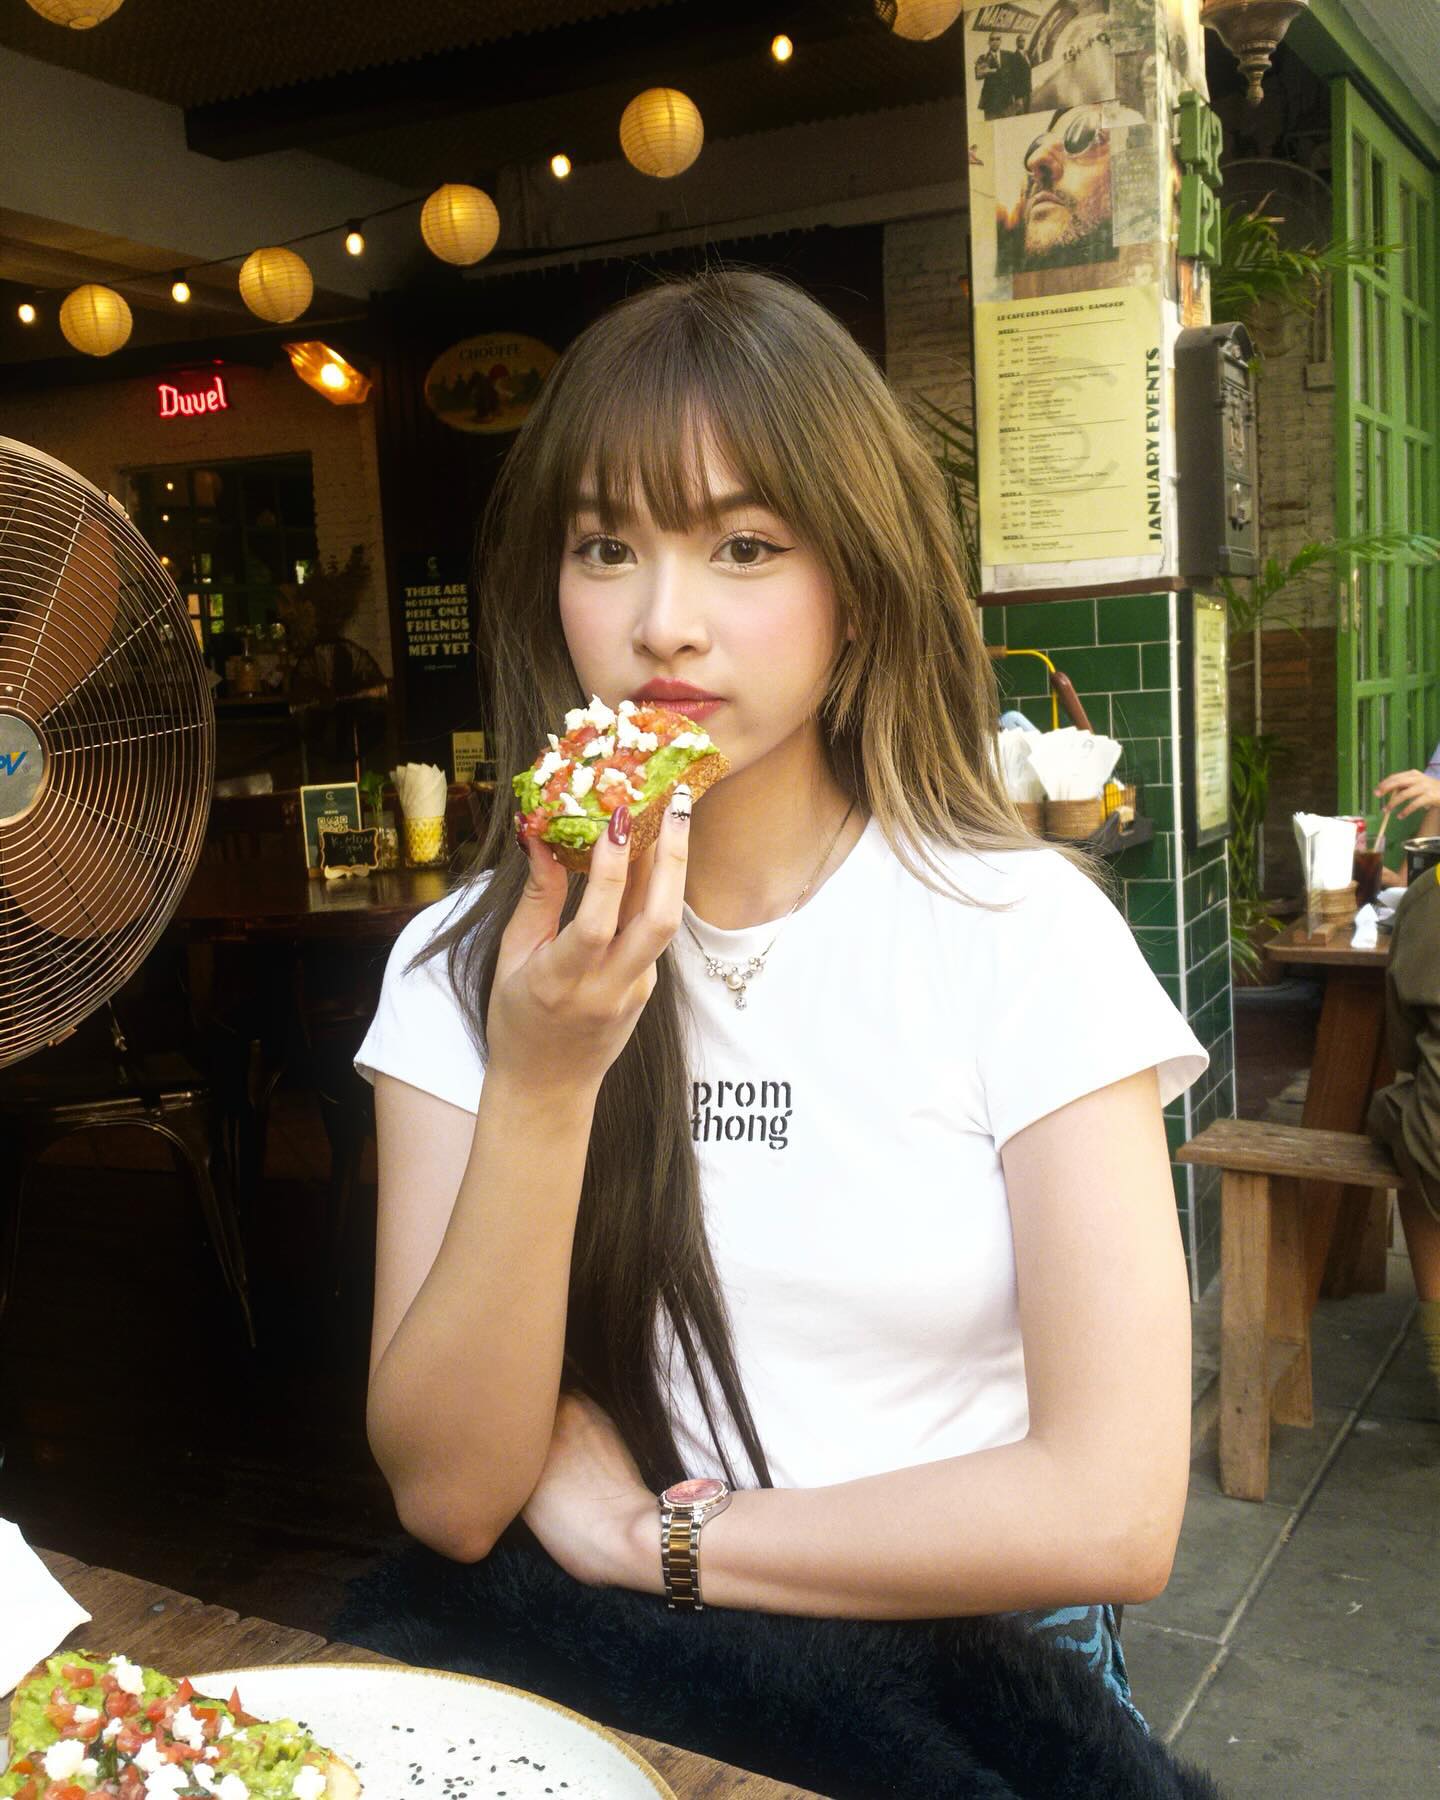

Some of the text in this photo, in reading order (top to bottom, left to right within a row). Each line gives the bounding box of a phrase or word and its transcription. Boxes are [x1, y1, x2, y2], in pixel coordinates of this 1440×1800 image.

[158, 376, 228, 417] Duvel
[1146, 347, 1162, 542] JANUARY EVENTS
[405, 584, 467, 597] THERE ARE
[406, 599, 418, 608] NO
[438, 606, 469, 617] ONLY
[406, 617, 470, 633] FRIENDS
[408, 631, 470, 643] YOU HAVE NOT
[408, 642, 471, 656] MET YET
[692, 1080, 792, 1115] prom
[690, 1106, 793, 1151] thong
